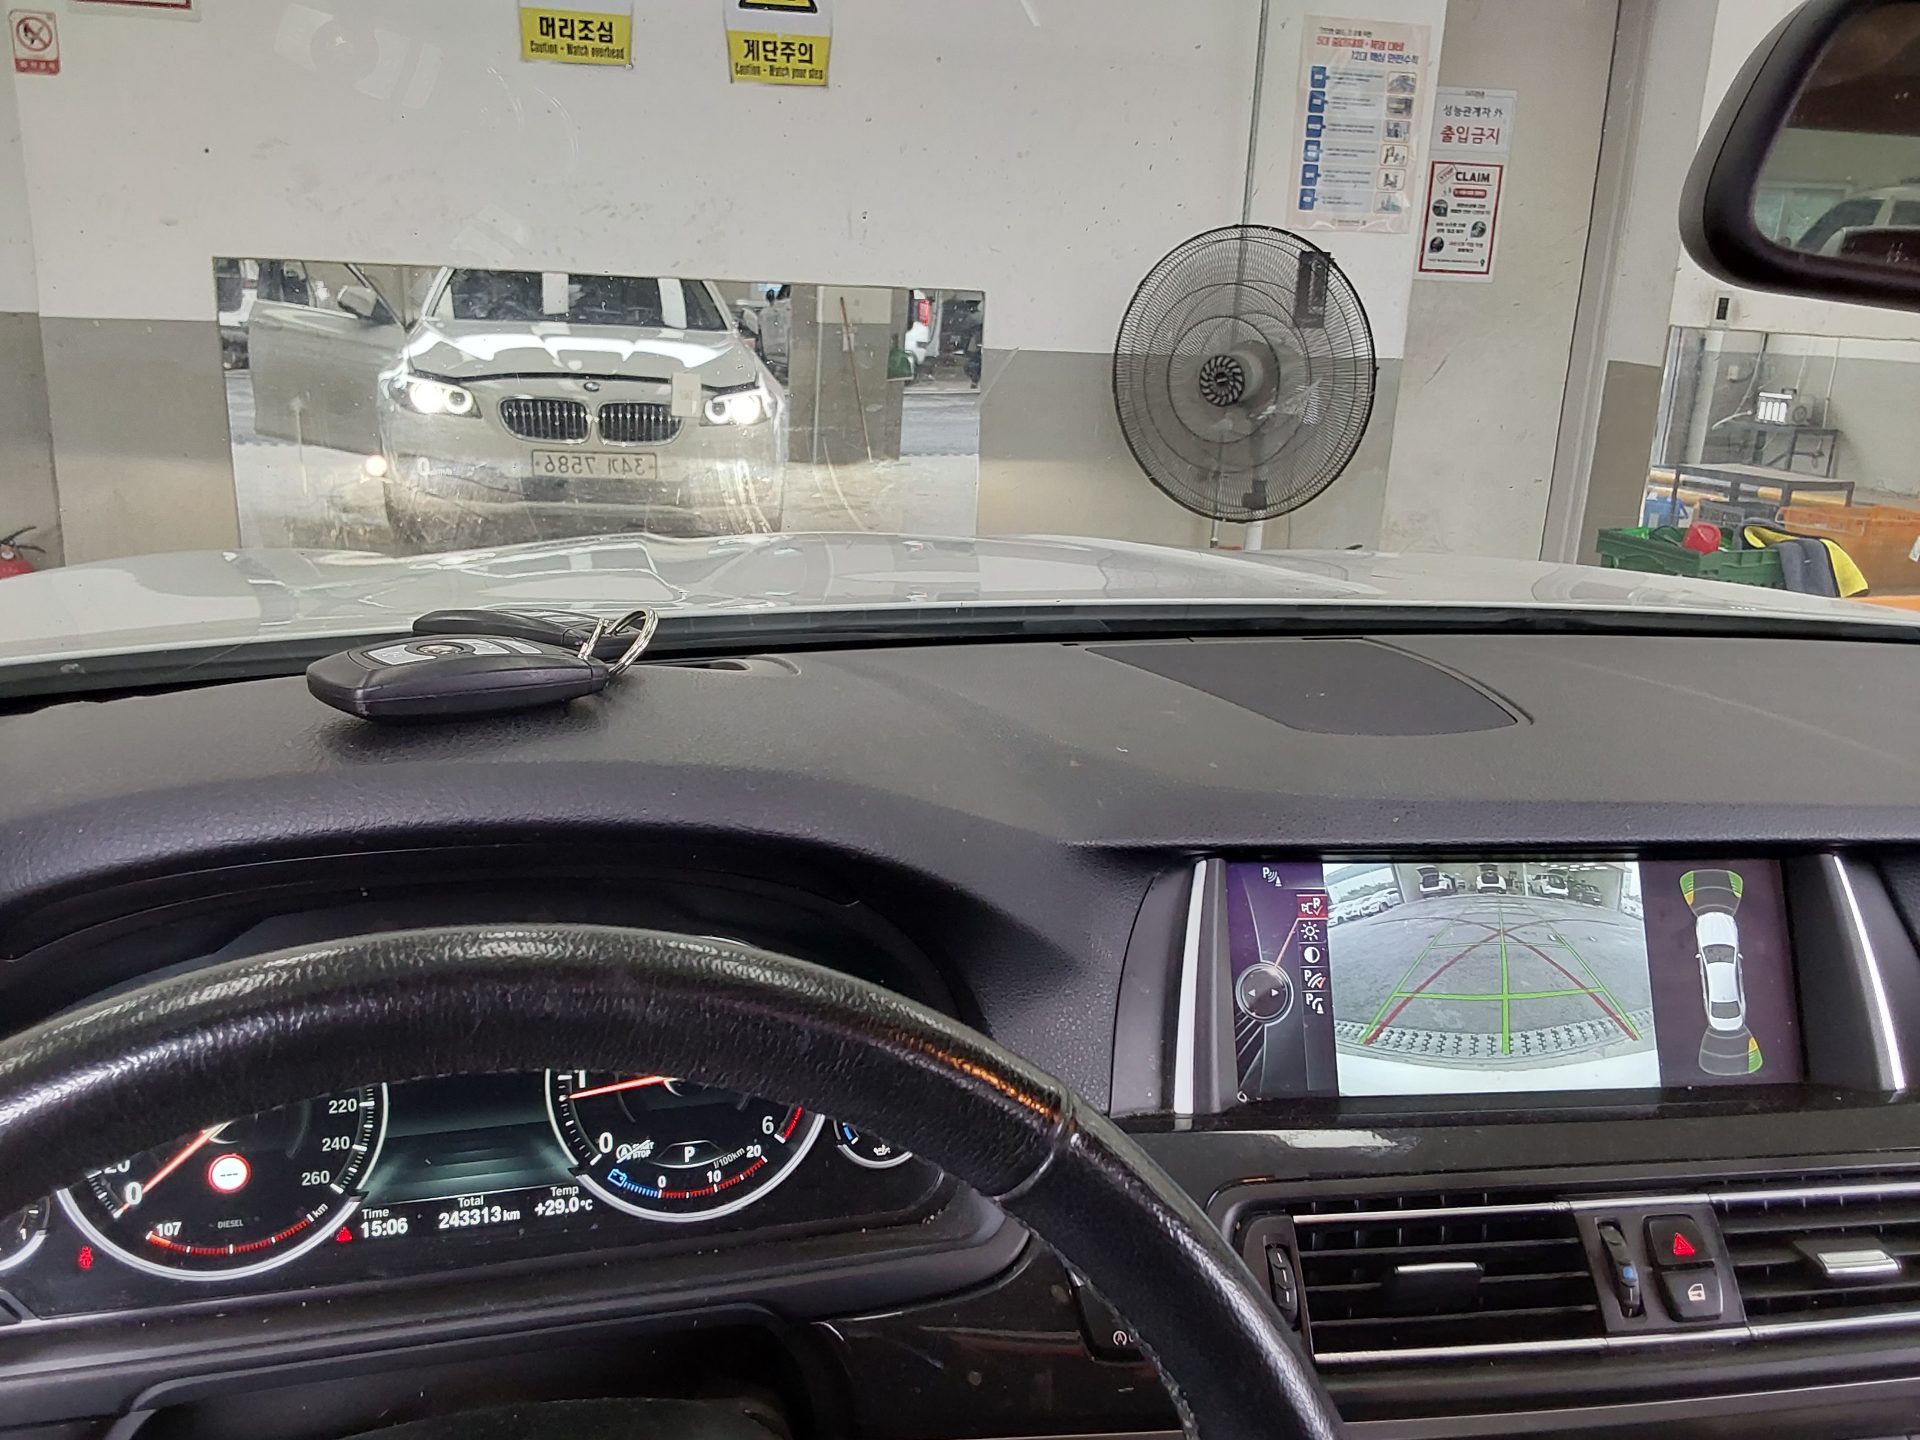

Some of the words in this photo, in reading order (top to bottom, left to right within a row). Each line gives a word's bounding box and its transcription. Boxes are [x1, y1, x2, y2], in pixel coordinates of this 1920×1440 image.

[539, 16, 613, 43] 머리조심
[744, 39, 813, 64] 계단주의
[1440, 125, 1500, 145] 출입금지
[1455, 171, 1490, 183] CLAIM
[328, 1098, 358, 1114] 220
[761, 1115, 774, 1135] 6
[321, 1136, 350, 1152] 240
[599, 1132, 613, 1153] 0
[684, 1146, 695, 1162] P
[746, 1144, 762, 1158] 20
[302, 1169, 330, 1186] 260
[657, 1175, 667, 1188] 0
[706, 1170, 722, 1183] 10
[125, 1181, 142, 1205] 0
[550, 1184, 579, 1197] Temp
[457, 1195, 484, 1208] Total
[311, 1203, 329, 1219] km
[361, 1208, 389, 1220] Time
[156, 1221, 182, 1237] 107
[217, 1218, 244, 1229] DIESEL
[360, 1218, 408, 1238] 15:06
